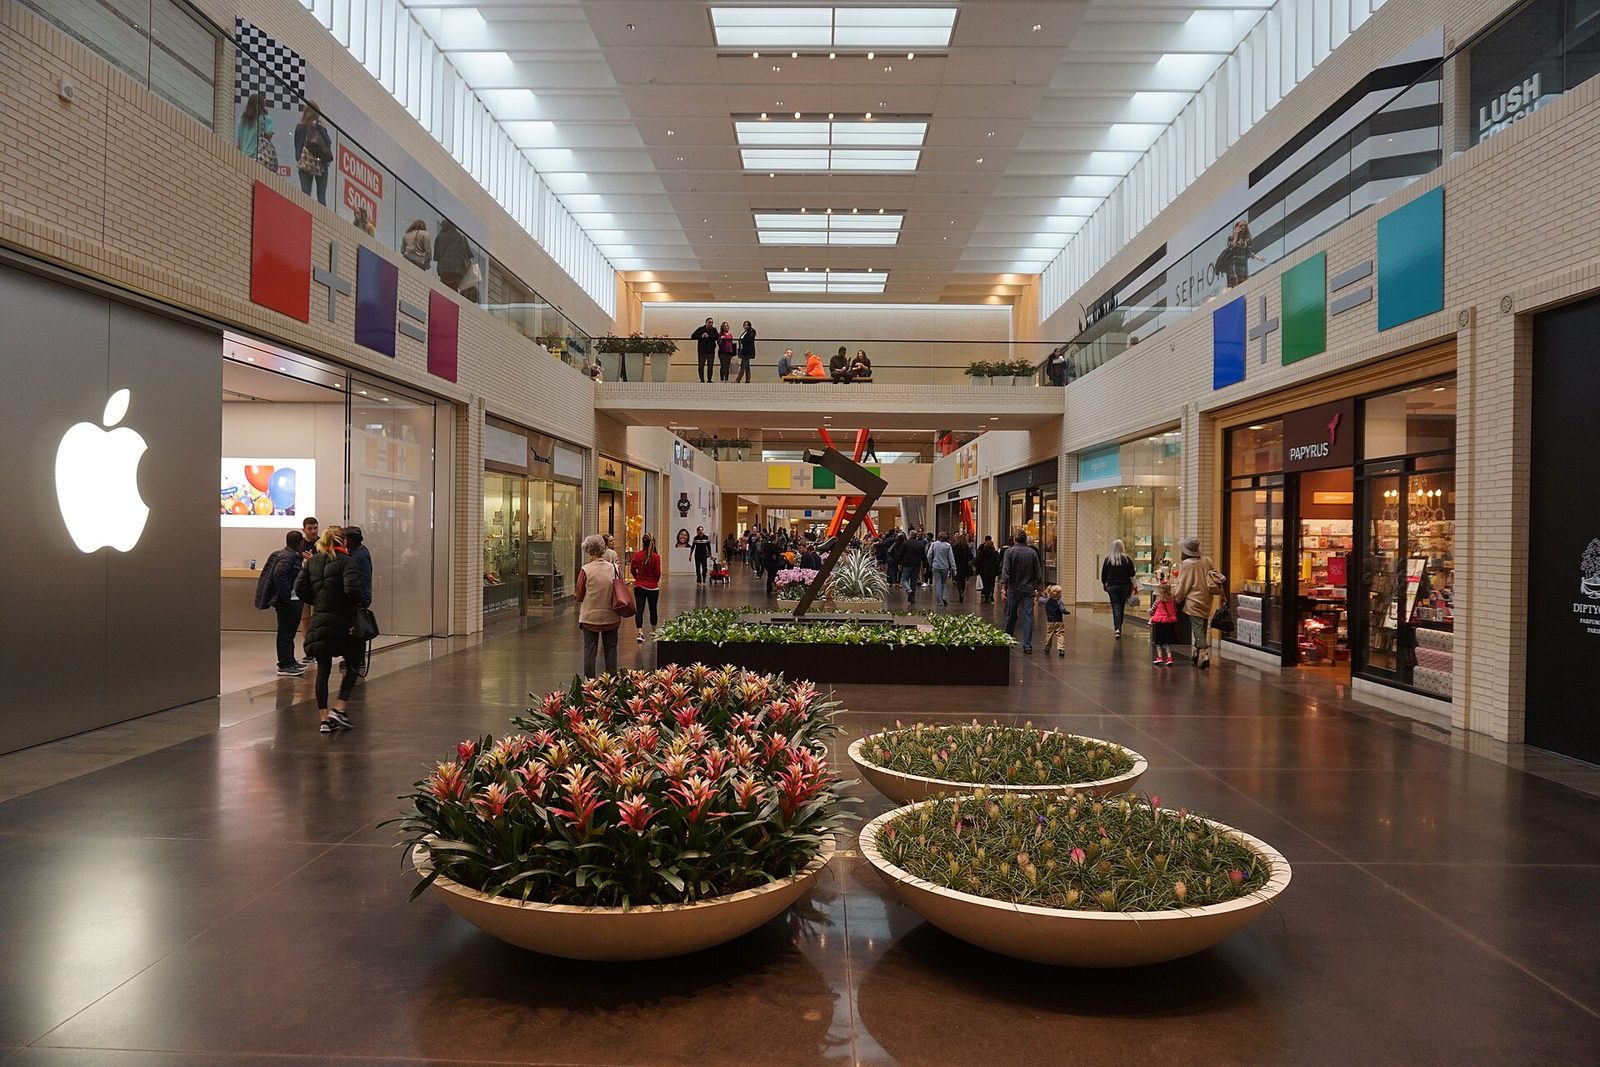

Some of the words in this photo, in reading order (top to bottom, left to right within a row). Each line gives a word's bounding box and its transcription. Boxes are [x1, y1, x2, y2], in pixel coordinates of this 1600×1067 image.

[1480, 72, 1540, 131] LUSH
[343, 151, 380, 193] COMING
[1290, 442, 1329, 461] PAPYRUS
